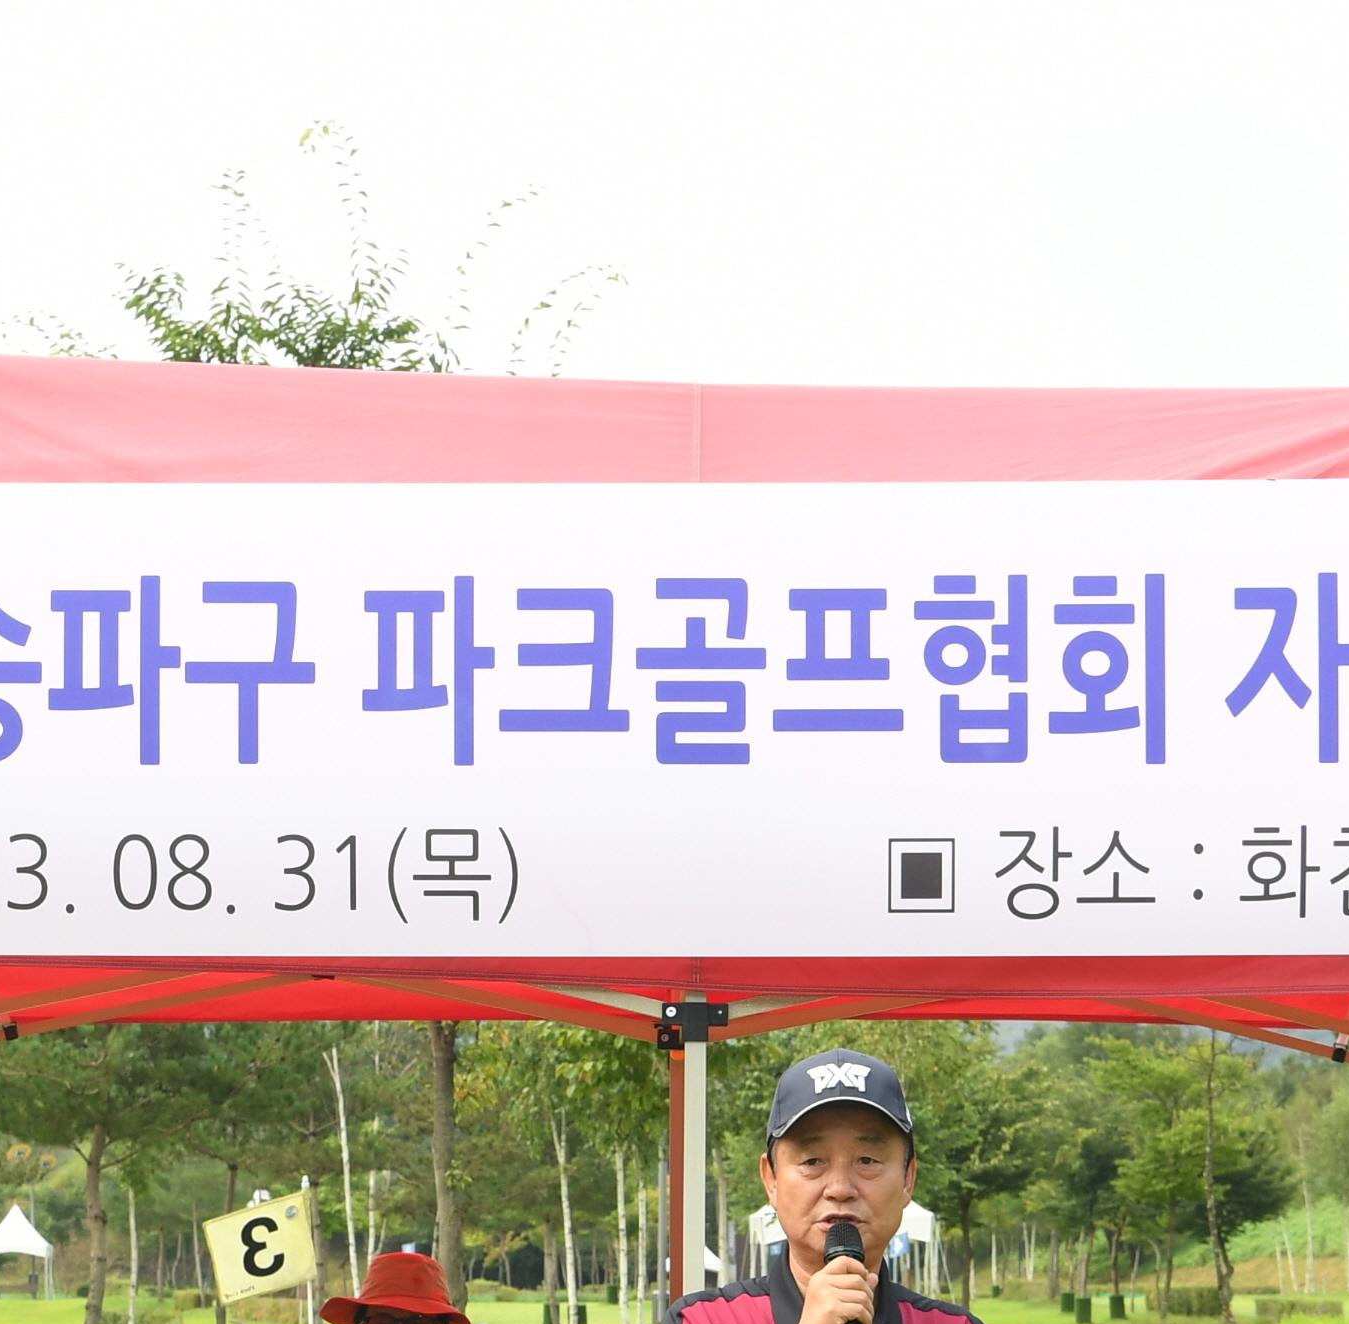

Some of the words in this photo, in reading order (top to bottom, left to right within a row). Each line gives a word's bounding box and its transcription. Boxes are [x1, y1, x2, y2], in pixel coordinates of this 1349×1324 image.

[362, 573, 1166, 766] 파크골프협회
[112, 833, 237, 915] 08.
[274, 826, 519, 924] 31(목)
[994, 825, 1156, 920] 장소
[806, 1062, 871, 1094] PXG
